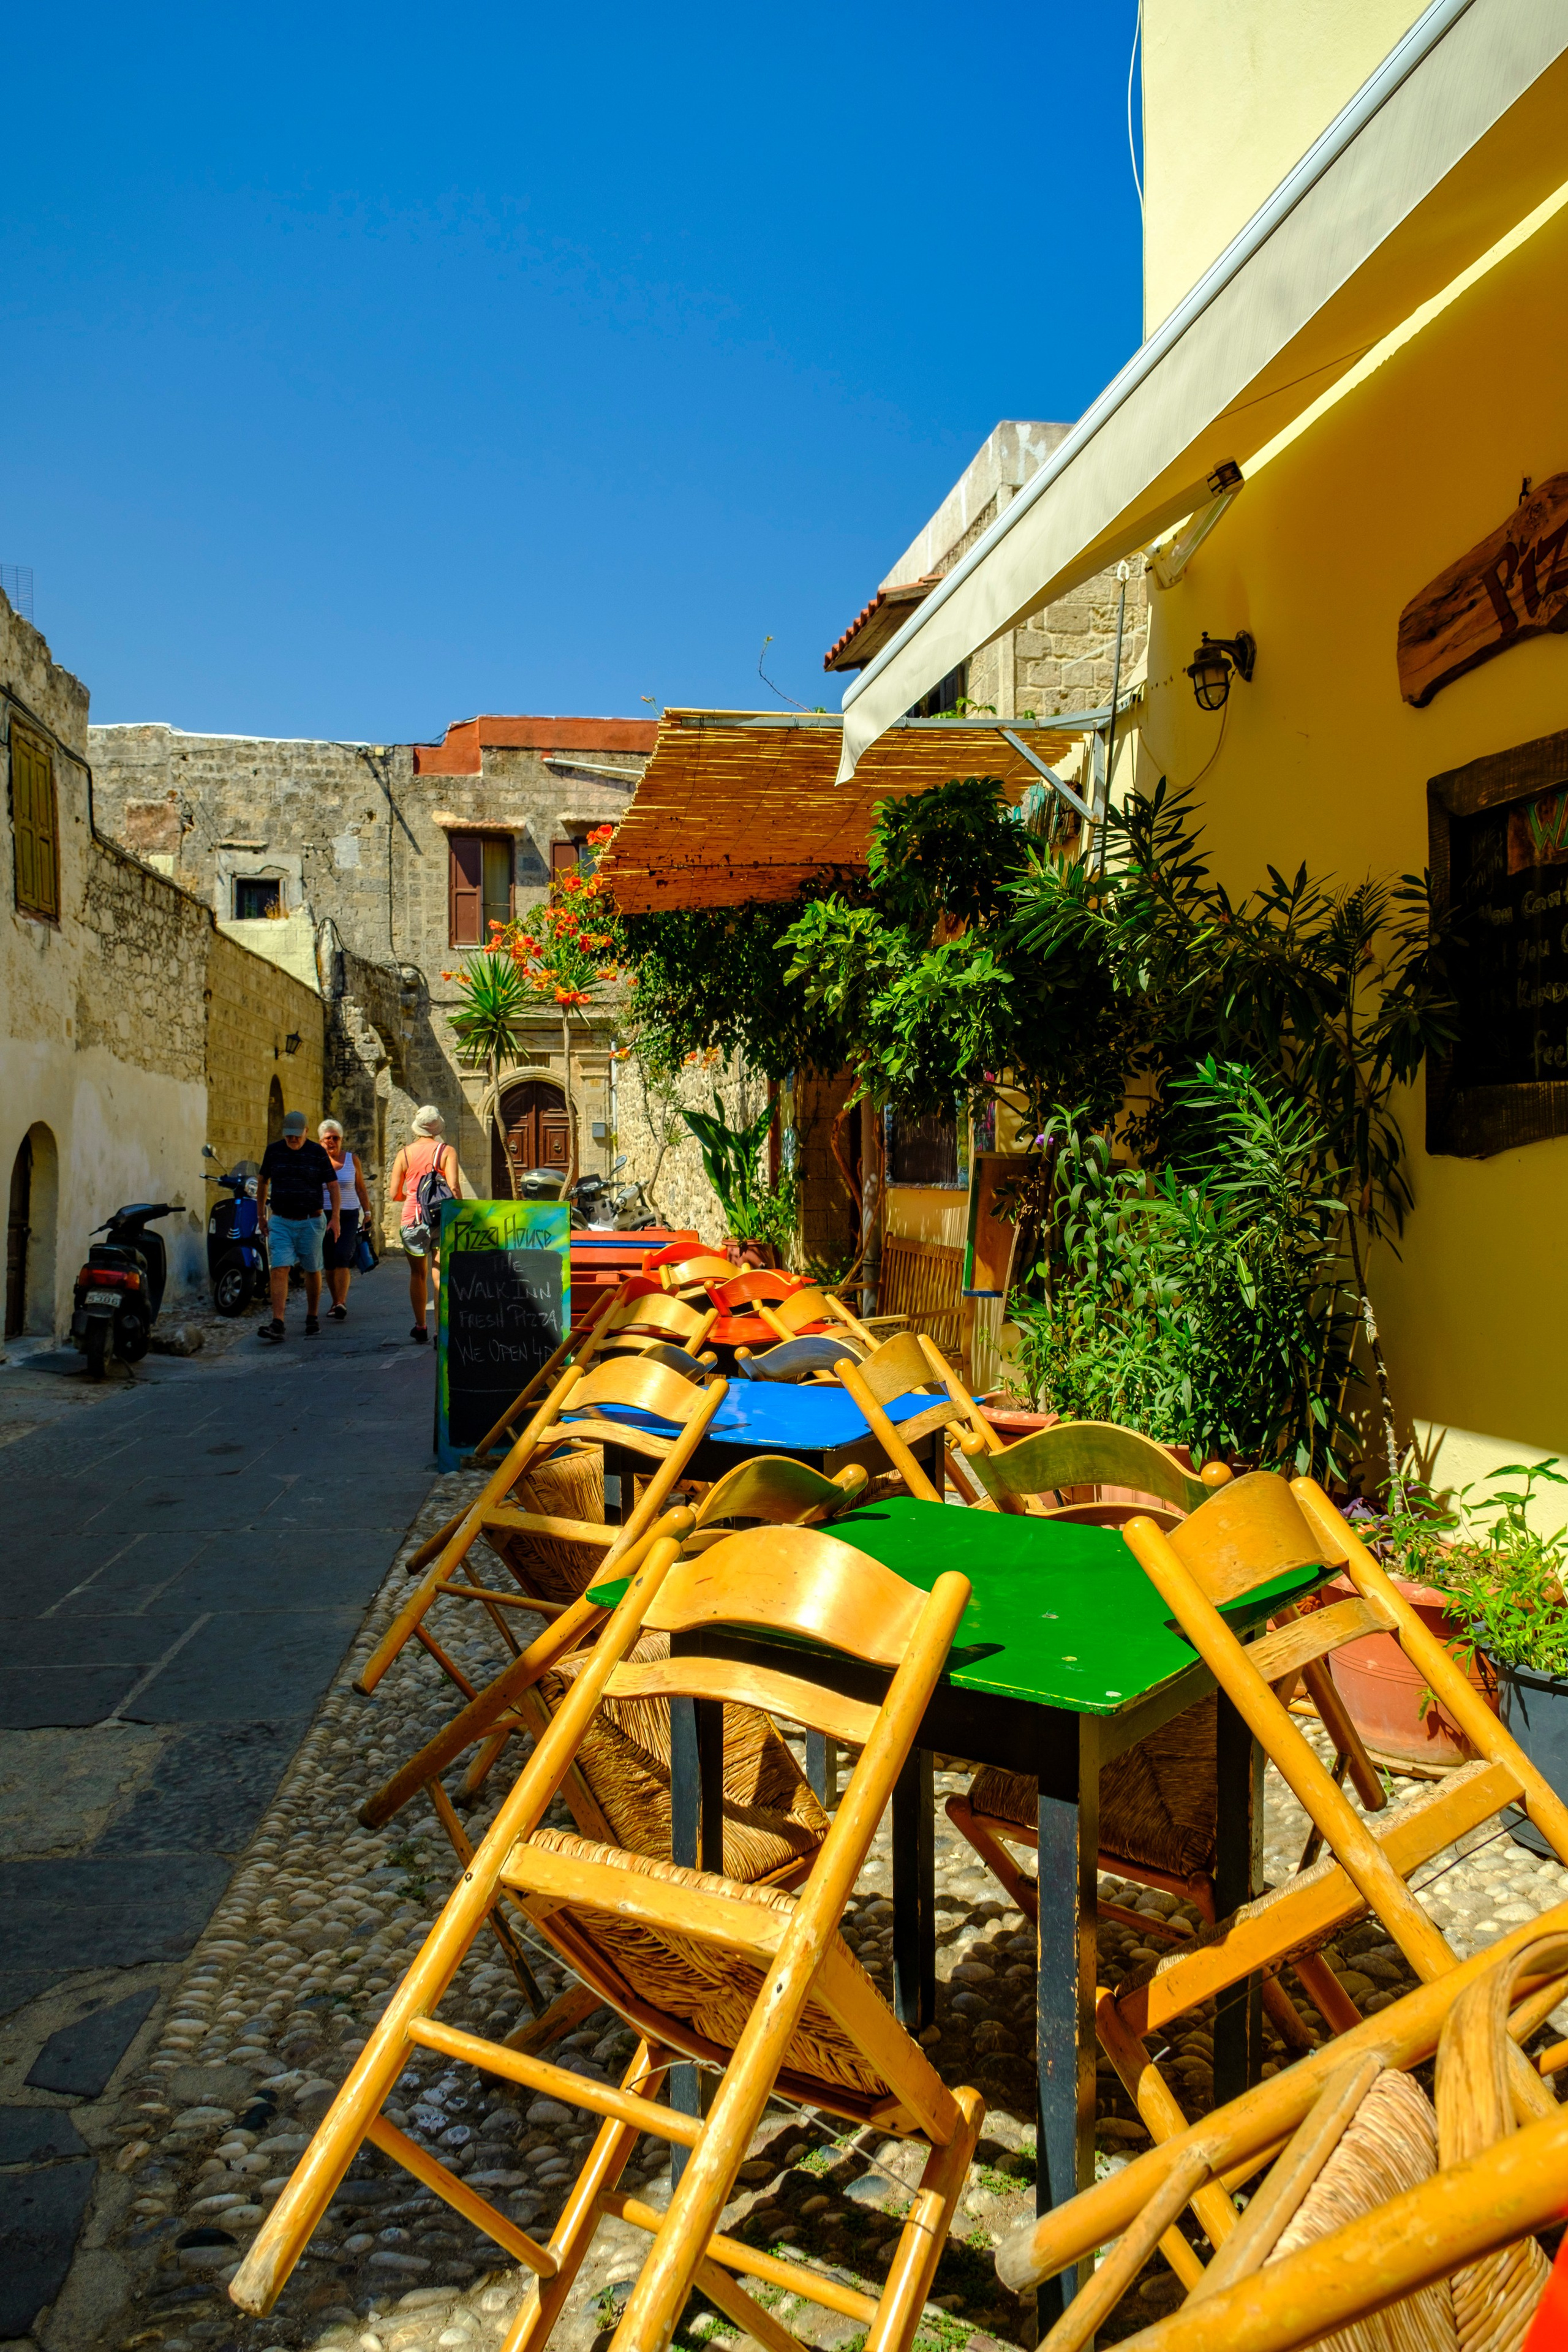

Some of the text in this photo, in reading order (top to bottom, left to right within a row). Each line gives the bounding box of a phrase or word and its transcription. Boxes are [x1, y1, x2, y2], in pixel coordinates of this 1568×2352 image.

[454, 1213, 552, 1251] Pizza House
[451, 1273, 510, 1301] WALK
[507, 1304, 558, 1332] PIZZA
[489, 1338, 527, 1362] OPEN
[532, 1336, 558, 1370] 4P
